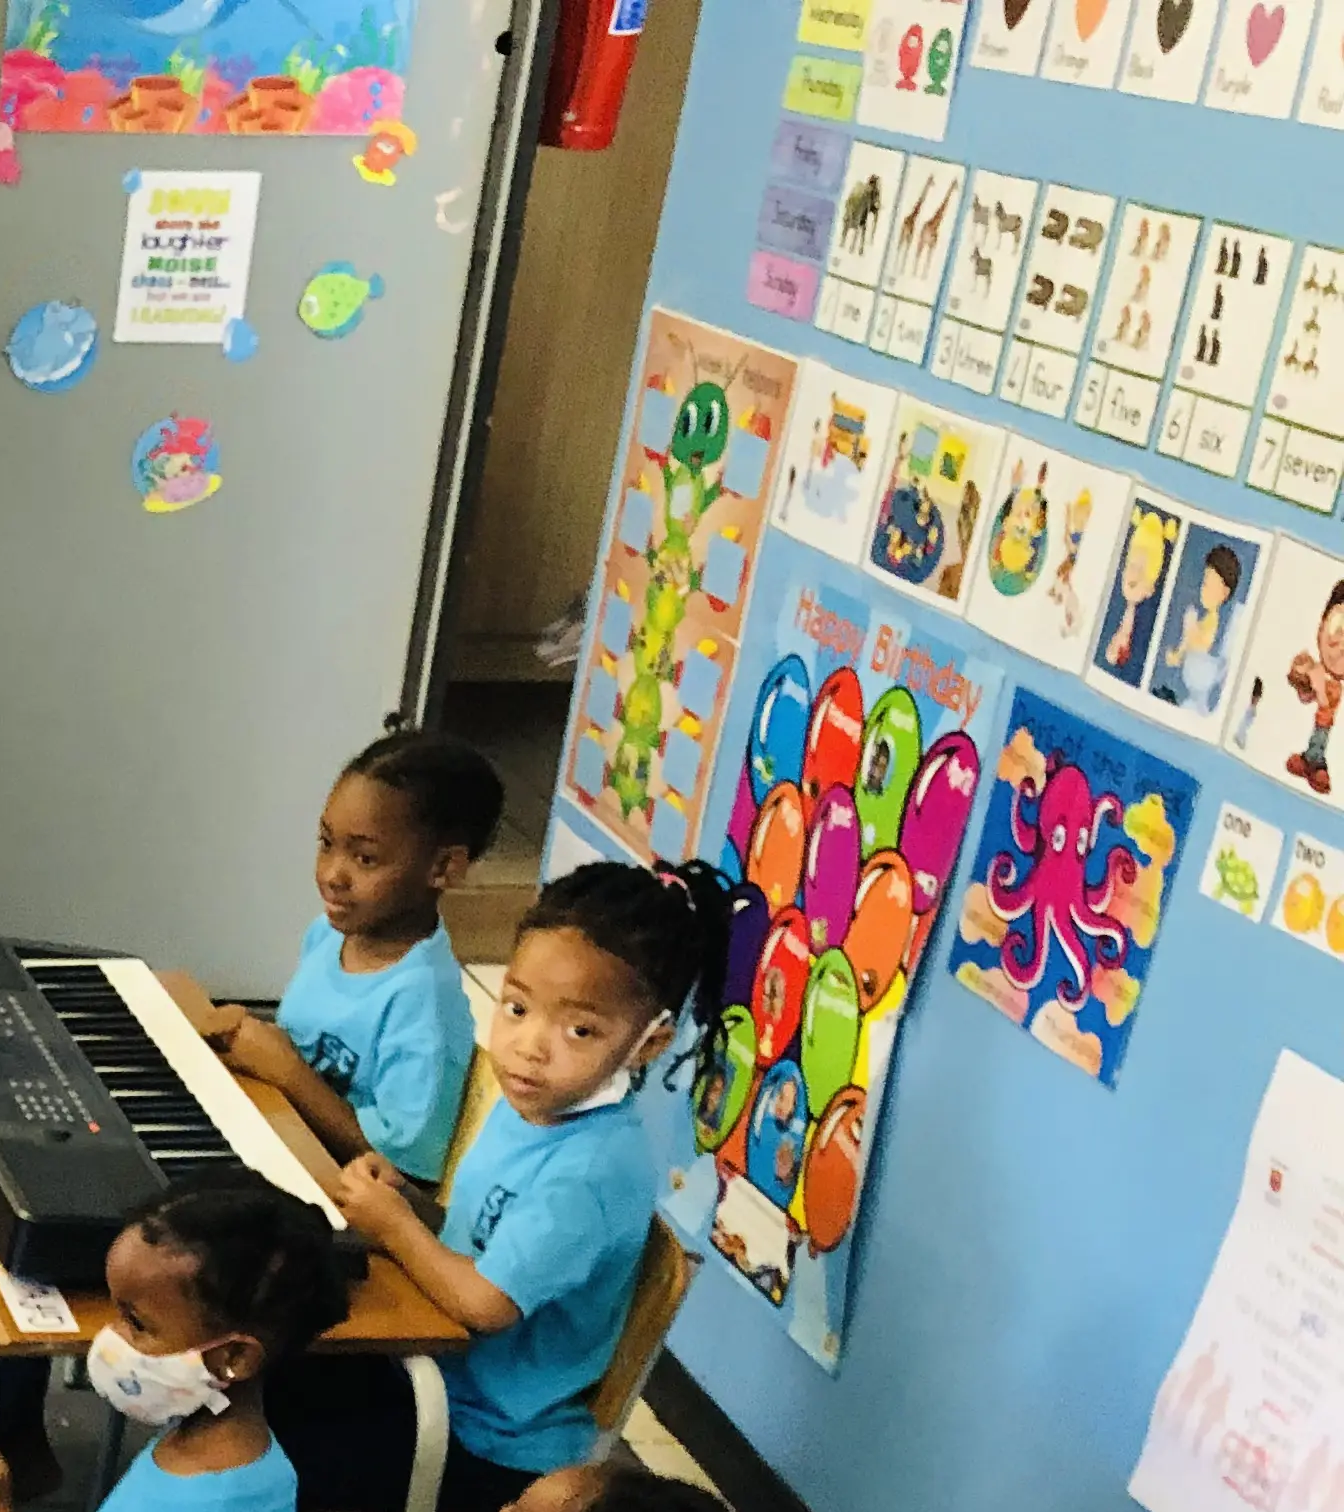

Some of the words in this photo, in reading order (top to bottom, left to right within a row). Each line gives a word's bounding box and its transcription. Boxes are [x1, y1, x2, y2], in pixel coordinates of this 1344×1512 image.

[141, 232, 229, 256] laughter
[939, 335, 953, 366] 3
[1030, 362, 1063, 399] four
[1083, 379, 1098, 411] 5
[1111, 386, 1142, 427] five
[1167, 408, 1182, 440] 6
[1199, 424, 1224, 455] six
[1260, 436, 1276, 471] 7
[1283, 454, 1338, 487] seven
[794, 583, 867, 668] Happy
[869, 623, 983, 730] Birthday
[1224, 812, 1252, 838] one
[1296, 838, 1326, 869] two
